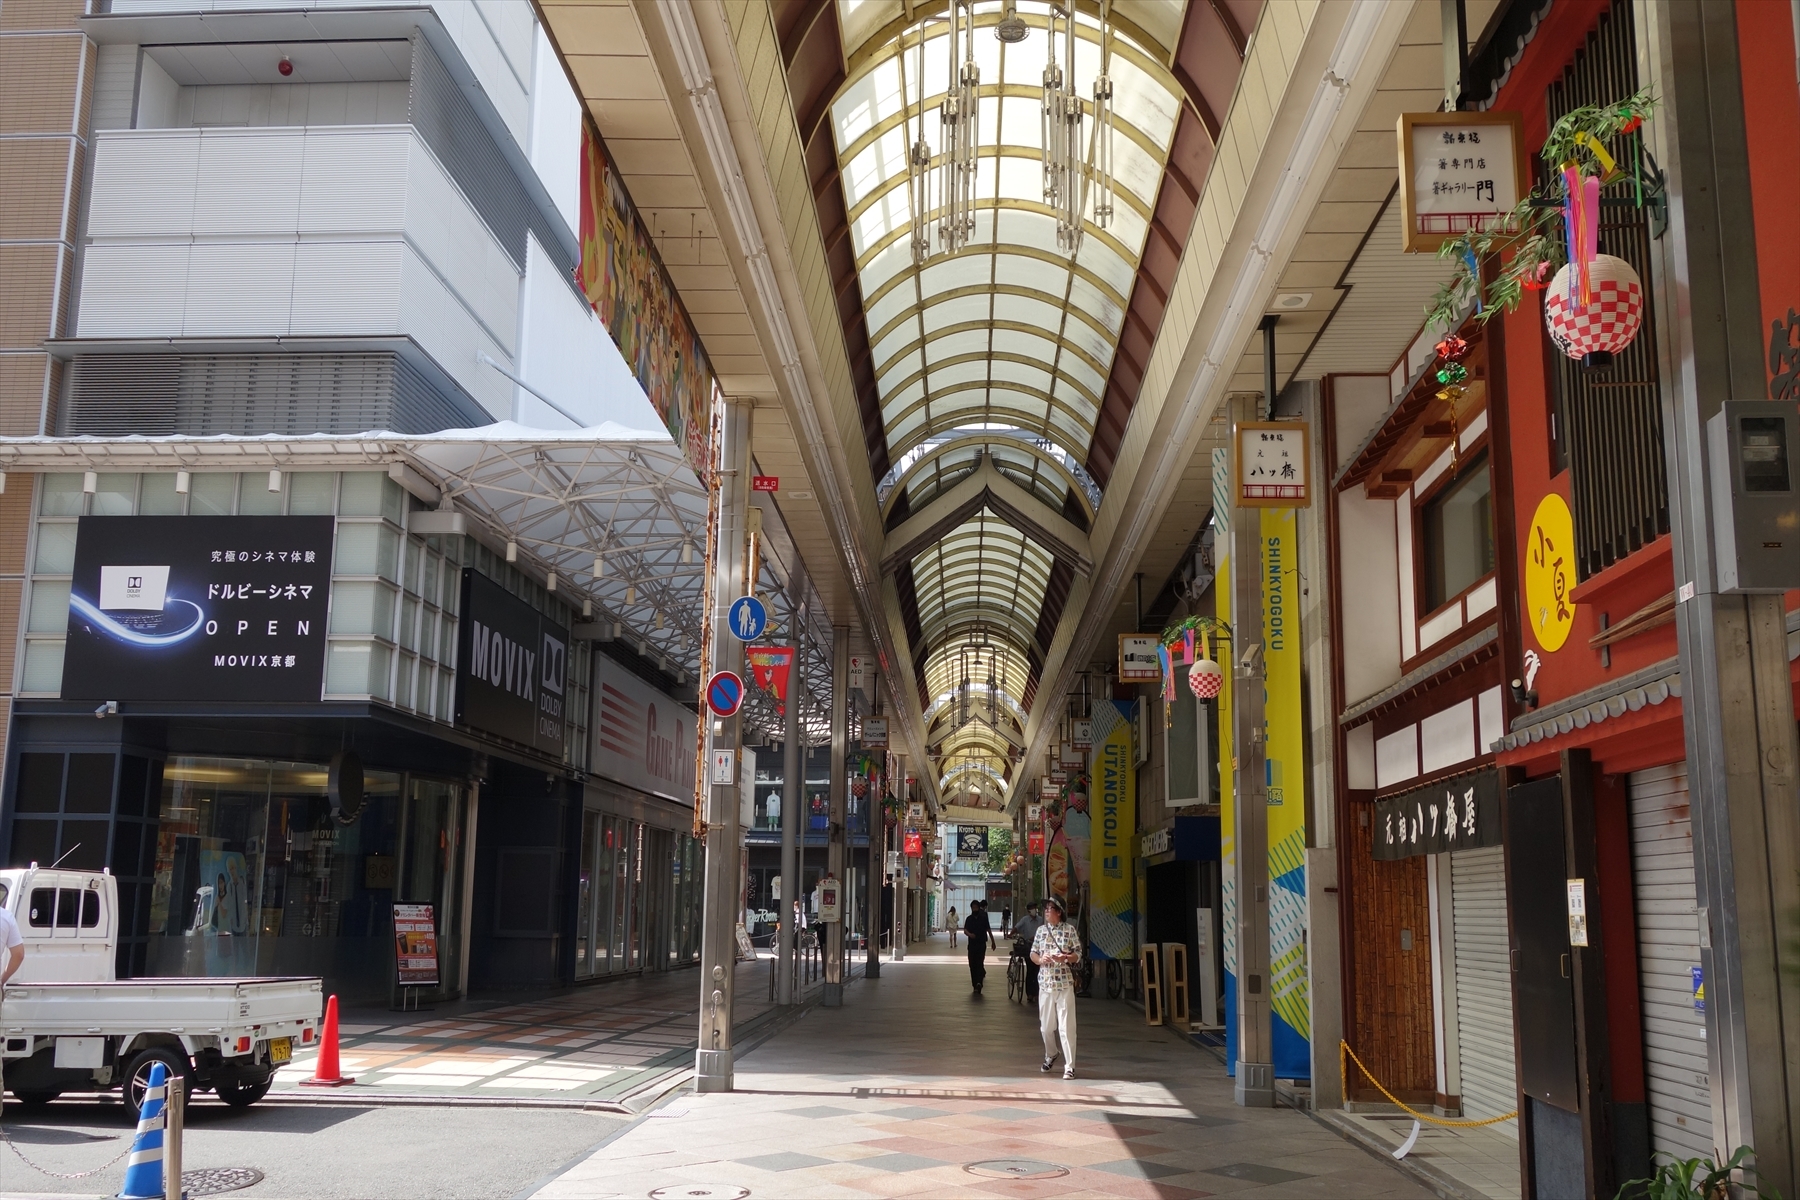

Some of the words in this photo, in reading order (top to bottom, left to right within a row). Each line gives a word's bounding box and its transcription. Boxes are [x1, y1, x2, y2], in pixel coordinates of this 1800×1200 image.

[1438, 158, 1486, 170] 箸専門店
[211, 550, 316, 563] 究極のシネマ体験
[208, 584, 314, 600] ドルビーシネマ
[1268, 537, 1284, 651] SHINKYOGOKU
[206, 620, 310, 636] OPEN
[214, 655, 296, 668] MOVIX京都
[471, 620, 535, 702] MOVIX
[540, 692, 562, 718] DOLBY
[539, 716, 561, 741] CINEMA
[646, 702, 673, 782] GAME
[1119, 745, 1127, 803] SHINKYOGOKU
[1104, 744, 1118, 848] UTANOKOJI
[312, 829, 340, 839] MOVIX
